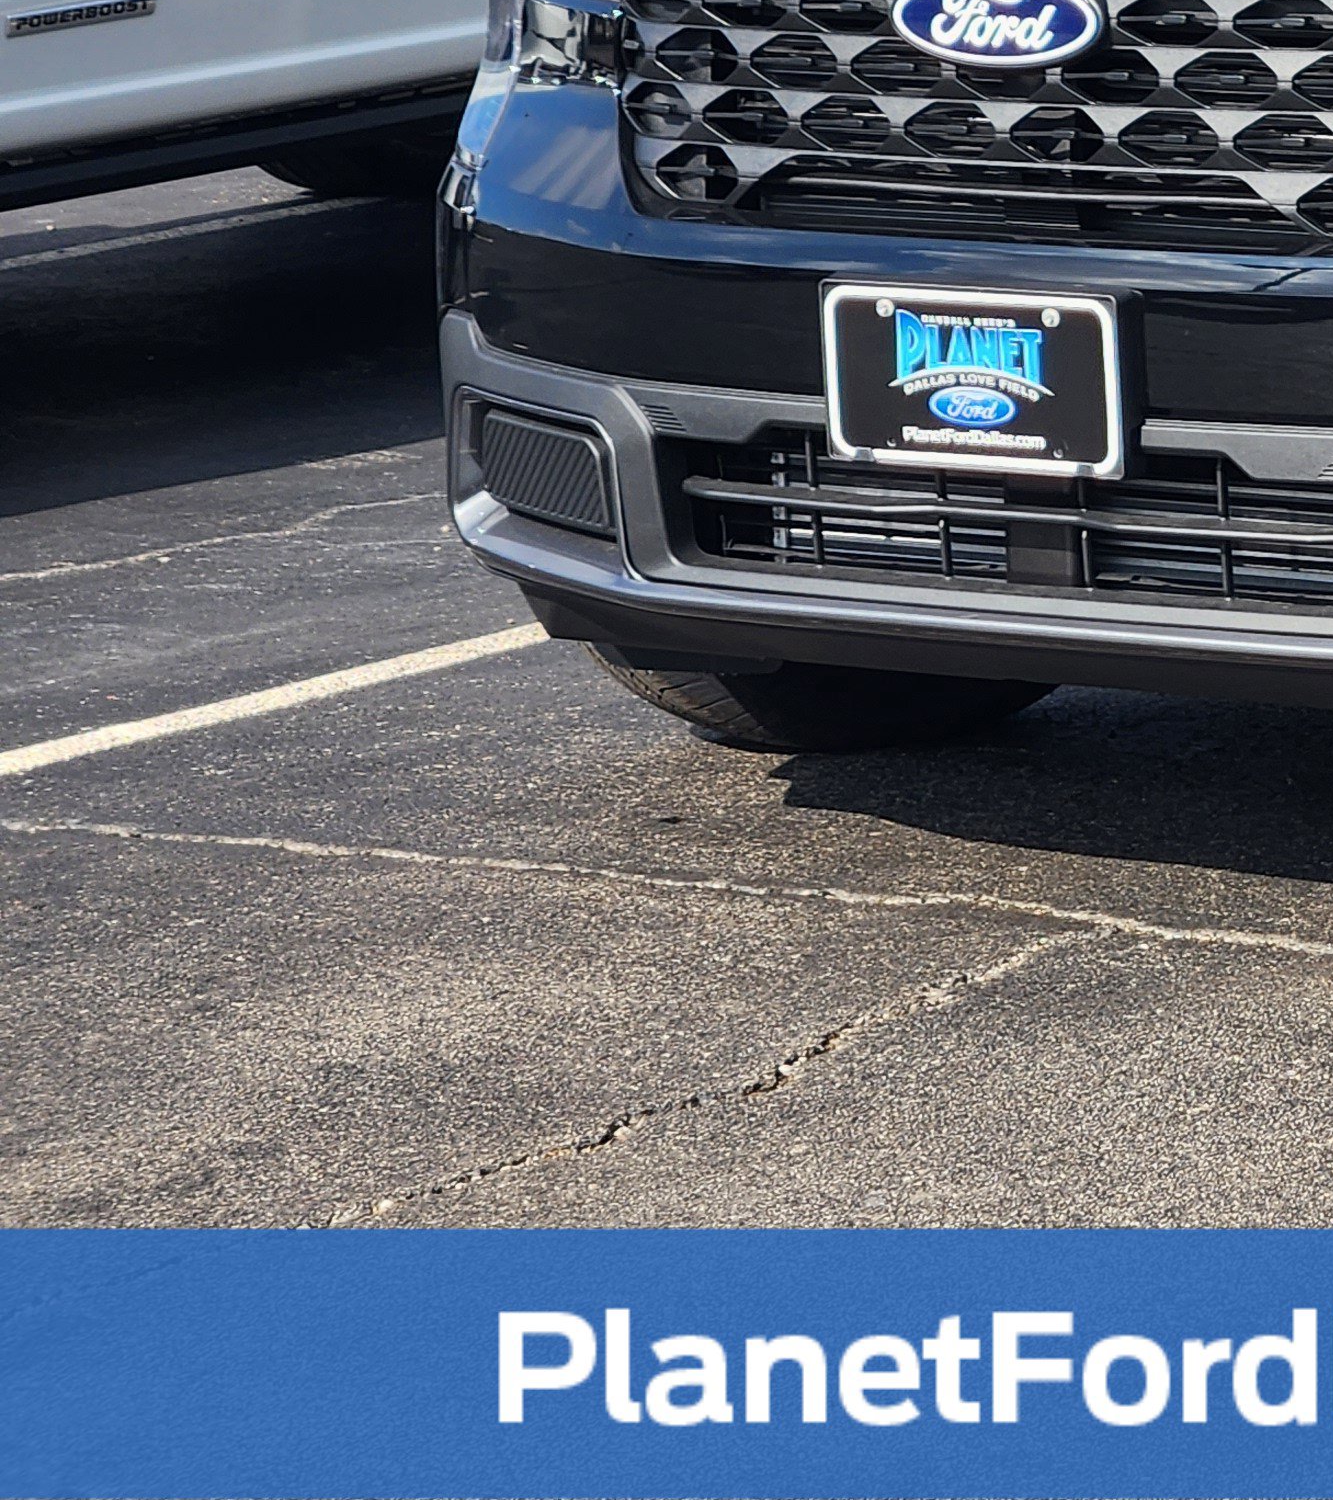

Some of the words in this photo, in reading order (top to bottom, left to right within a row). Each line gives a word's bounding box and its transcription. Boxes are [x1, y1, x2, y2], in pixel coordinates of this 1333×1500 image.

[13, 0, 150, 31] POWERBOOST
[895, 308, 1043, 385] PLANET
[902, 373, 957, 396] DALLAS
[958, 373, 997, 387] LOVE
[998, 378, 1041, 403] FIELD
[947, 393, 998, 420] Ford
